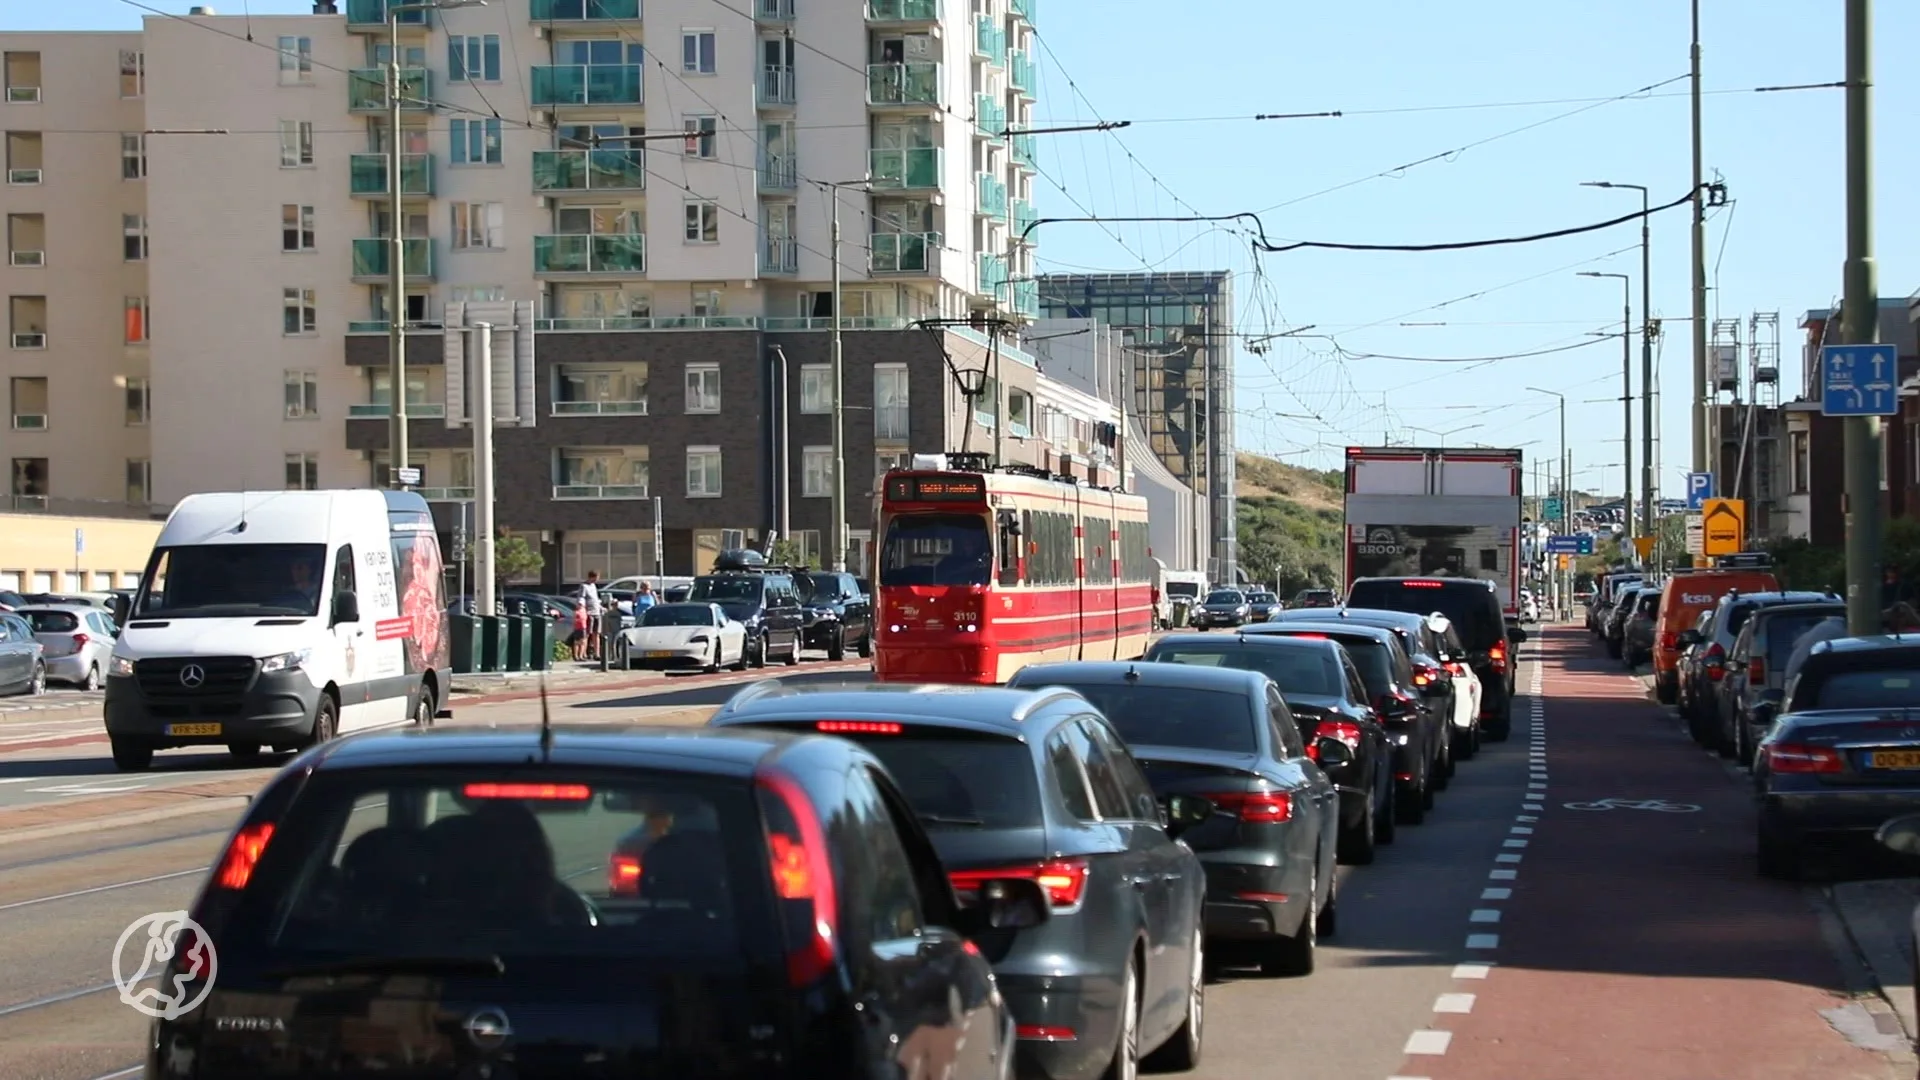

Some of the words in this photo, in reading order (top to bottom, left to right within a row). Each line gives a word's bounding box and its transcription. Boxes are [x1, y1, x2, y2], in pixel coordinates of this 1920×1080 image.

[1692, 476, 1707, 494] P
[1358, 545, 1404, 554] BROOD
[953, 611, 977, 621] 3110
[216, 1017, 285, 1030] CORSA
